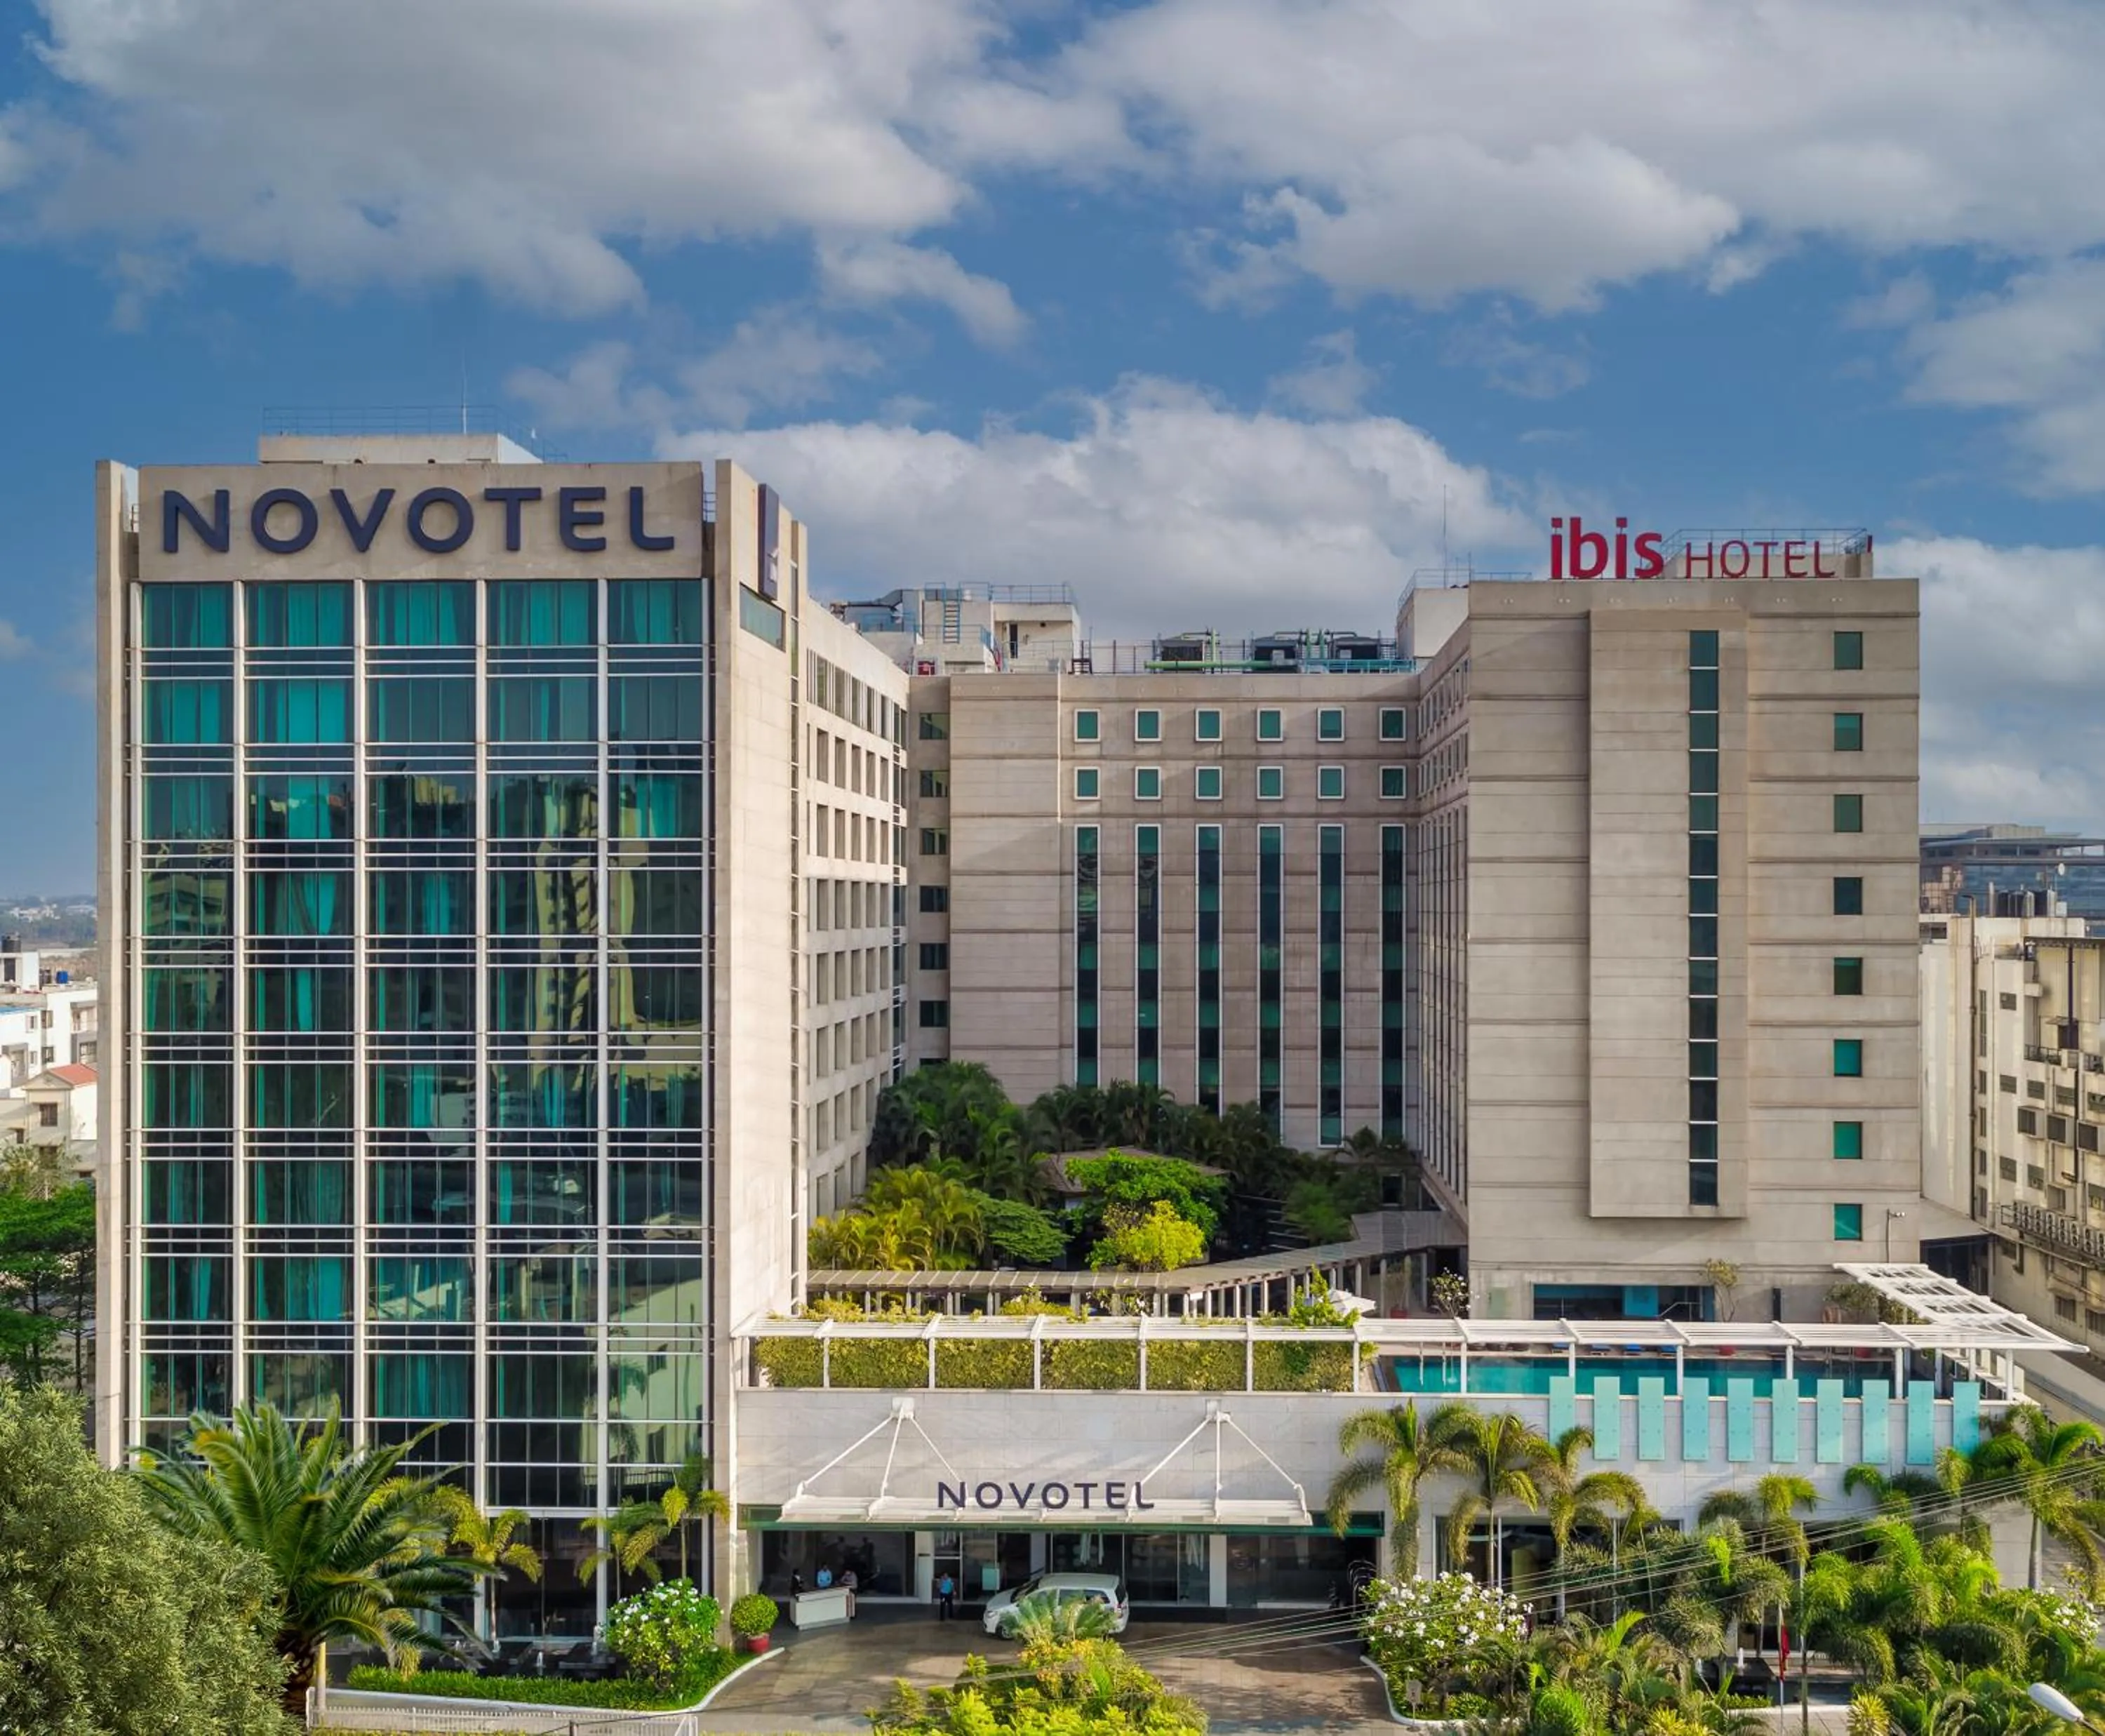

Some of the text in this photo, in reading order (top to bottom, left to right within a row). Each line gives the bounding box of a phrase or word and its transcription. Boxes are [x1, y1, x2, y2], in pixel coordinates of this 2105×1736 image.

[161, 486, 675, 554] NOVOTEL
[1551, 516, 1836, 580] ibis HOTEL
[937, 1481, 1154, 1509] NOVOTEL
